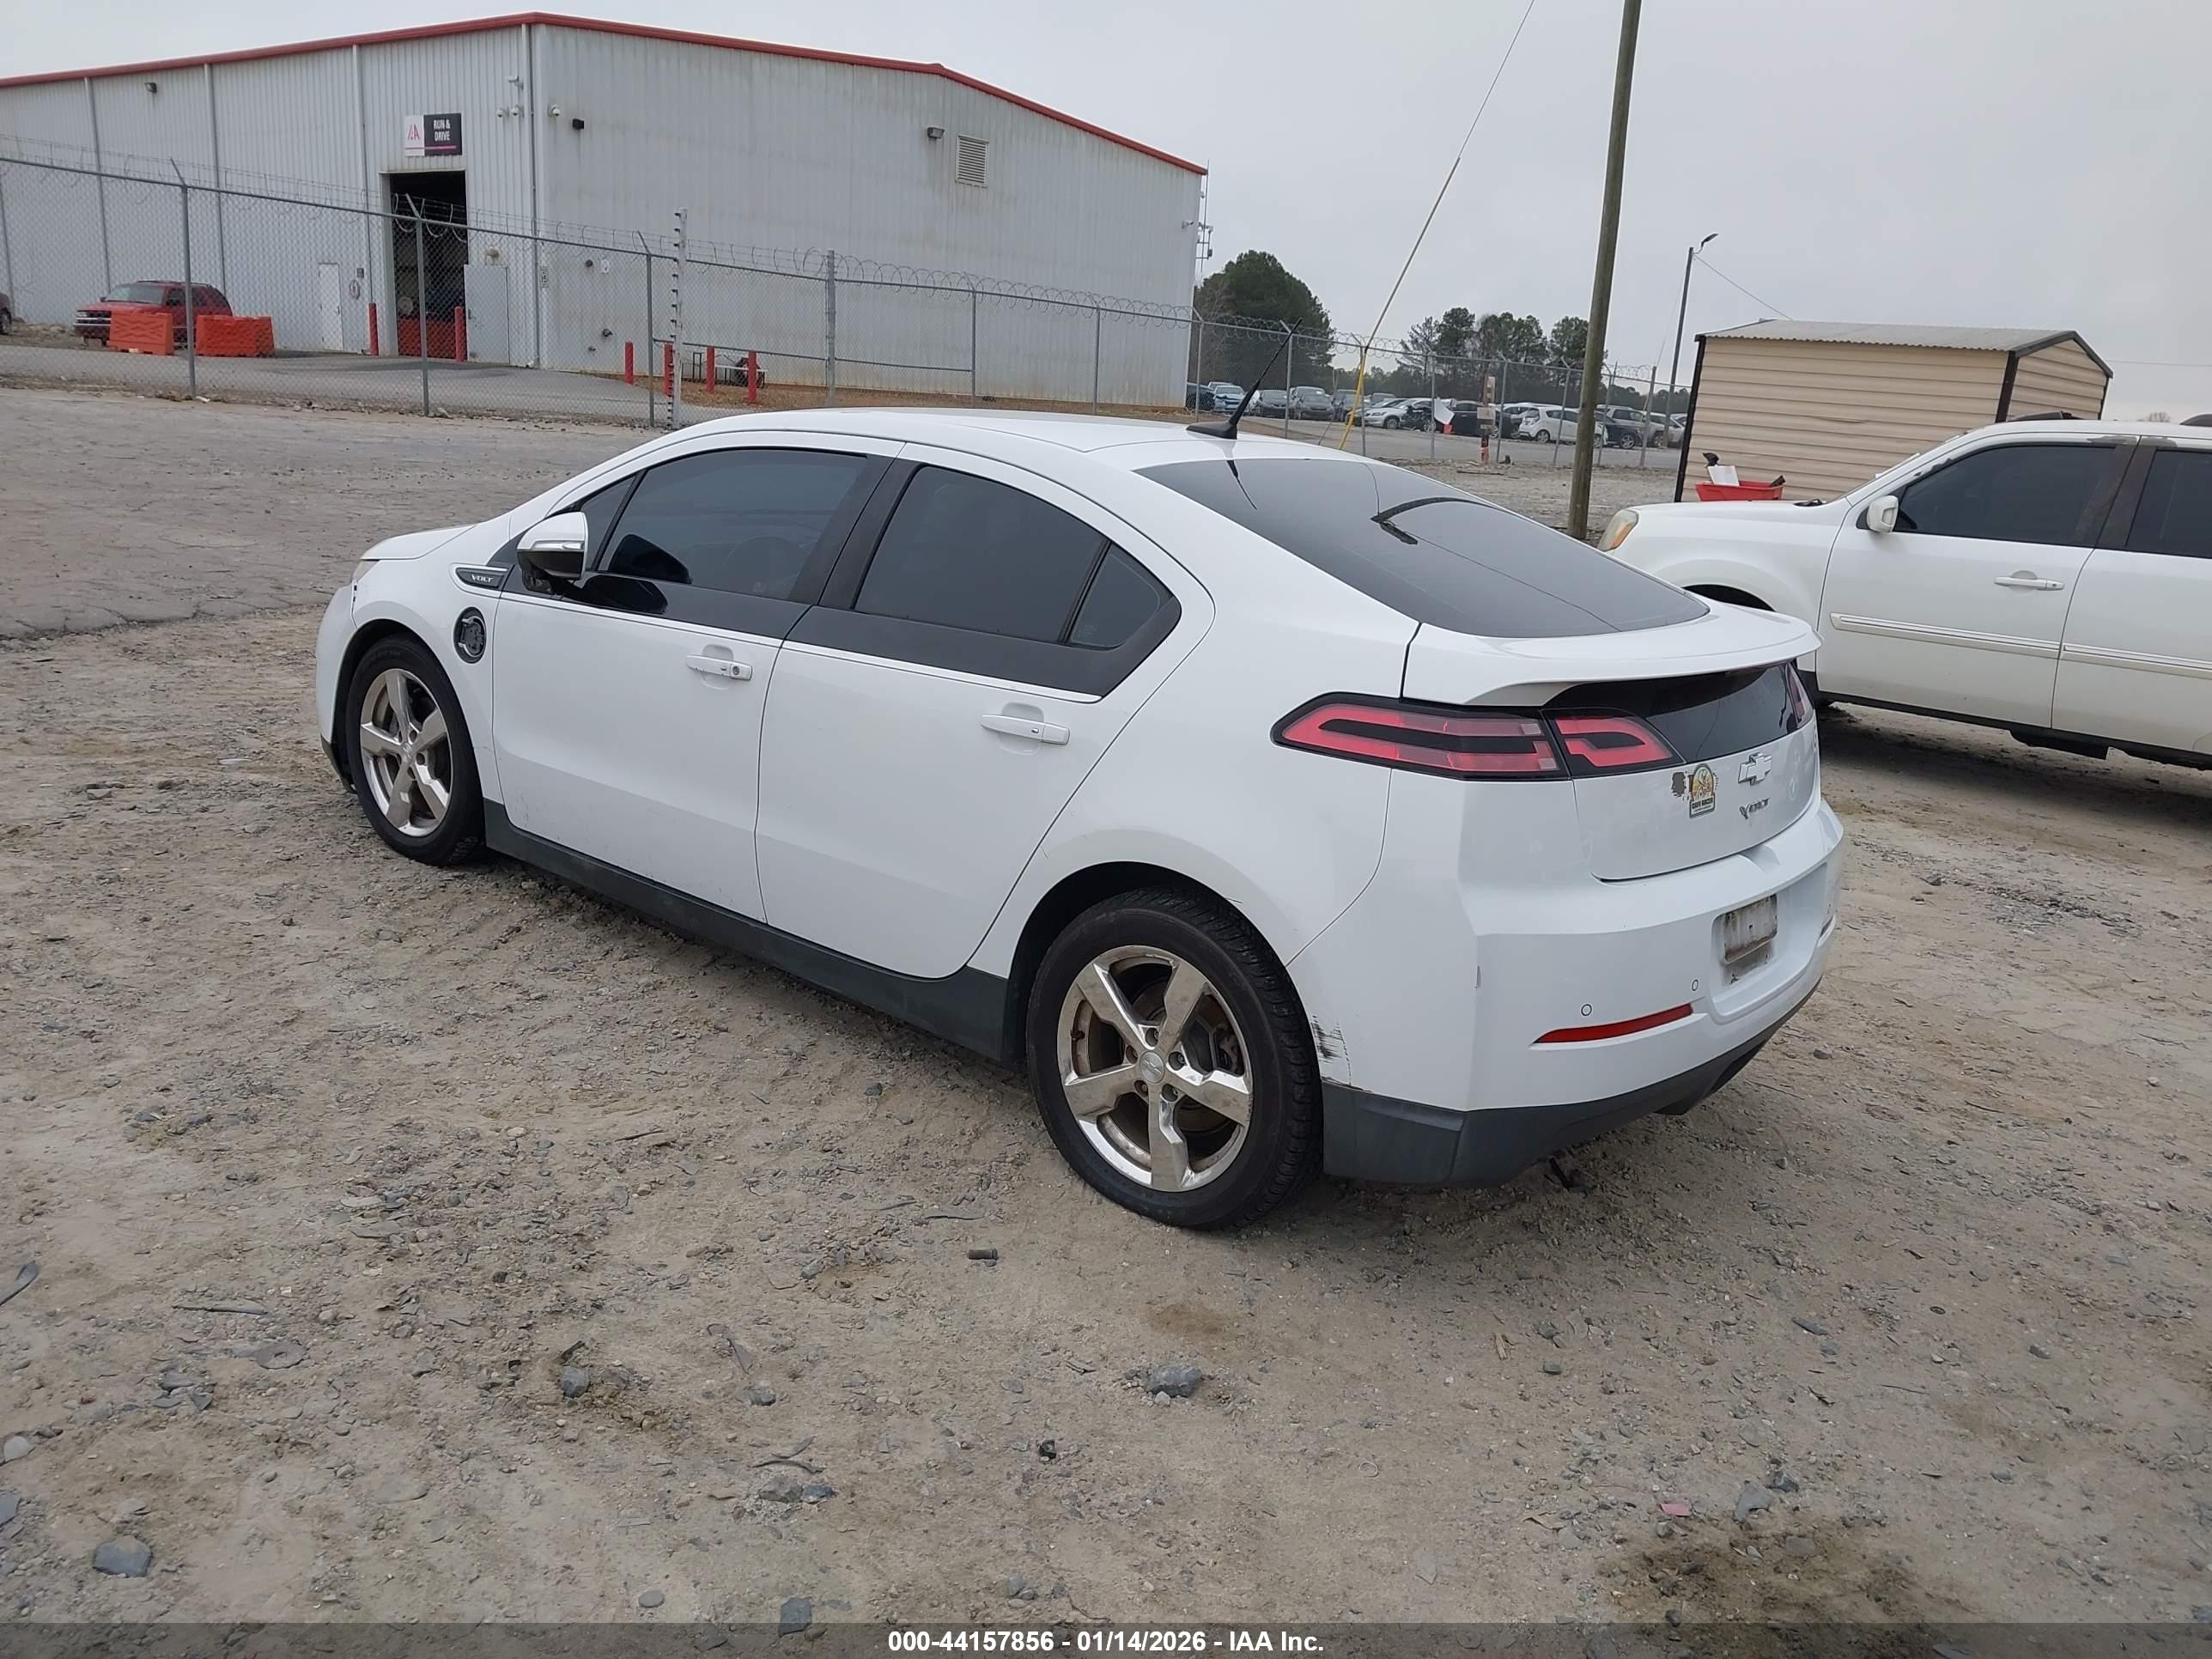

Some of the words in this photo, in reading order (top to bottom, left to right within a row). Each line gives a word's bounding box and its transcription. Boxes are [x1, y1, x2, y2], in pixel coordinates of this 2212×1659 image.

[434, 119, 445, 130] RUN
[446, 118, 451, 129] &
[434, 131, 450, 142] DRIVE
[471, 574, 494, 583] VOLT
[1739, 798, 1771, 819] VOLT
